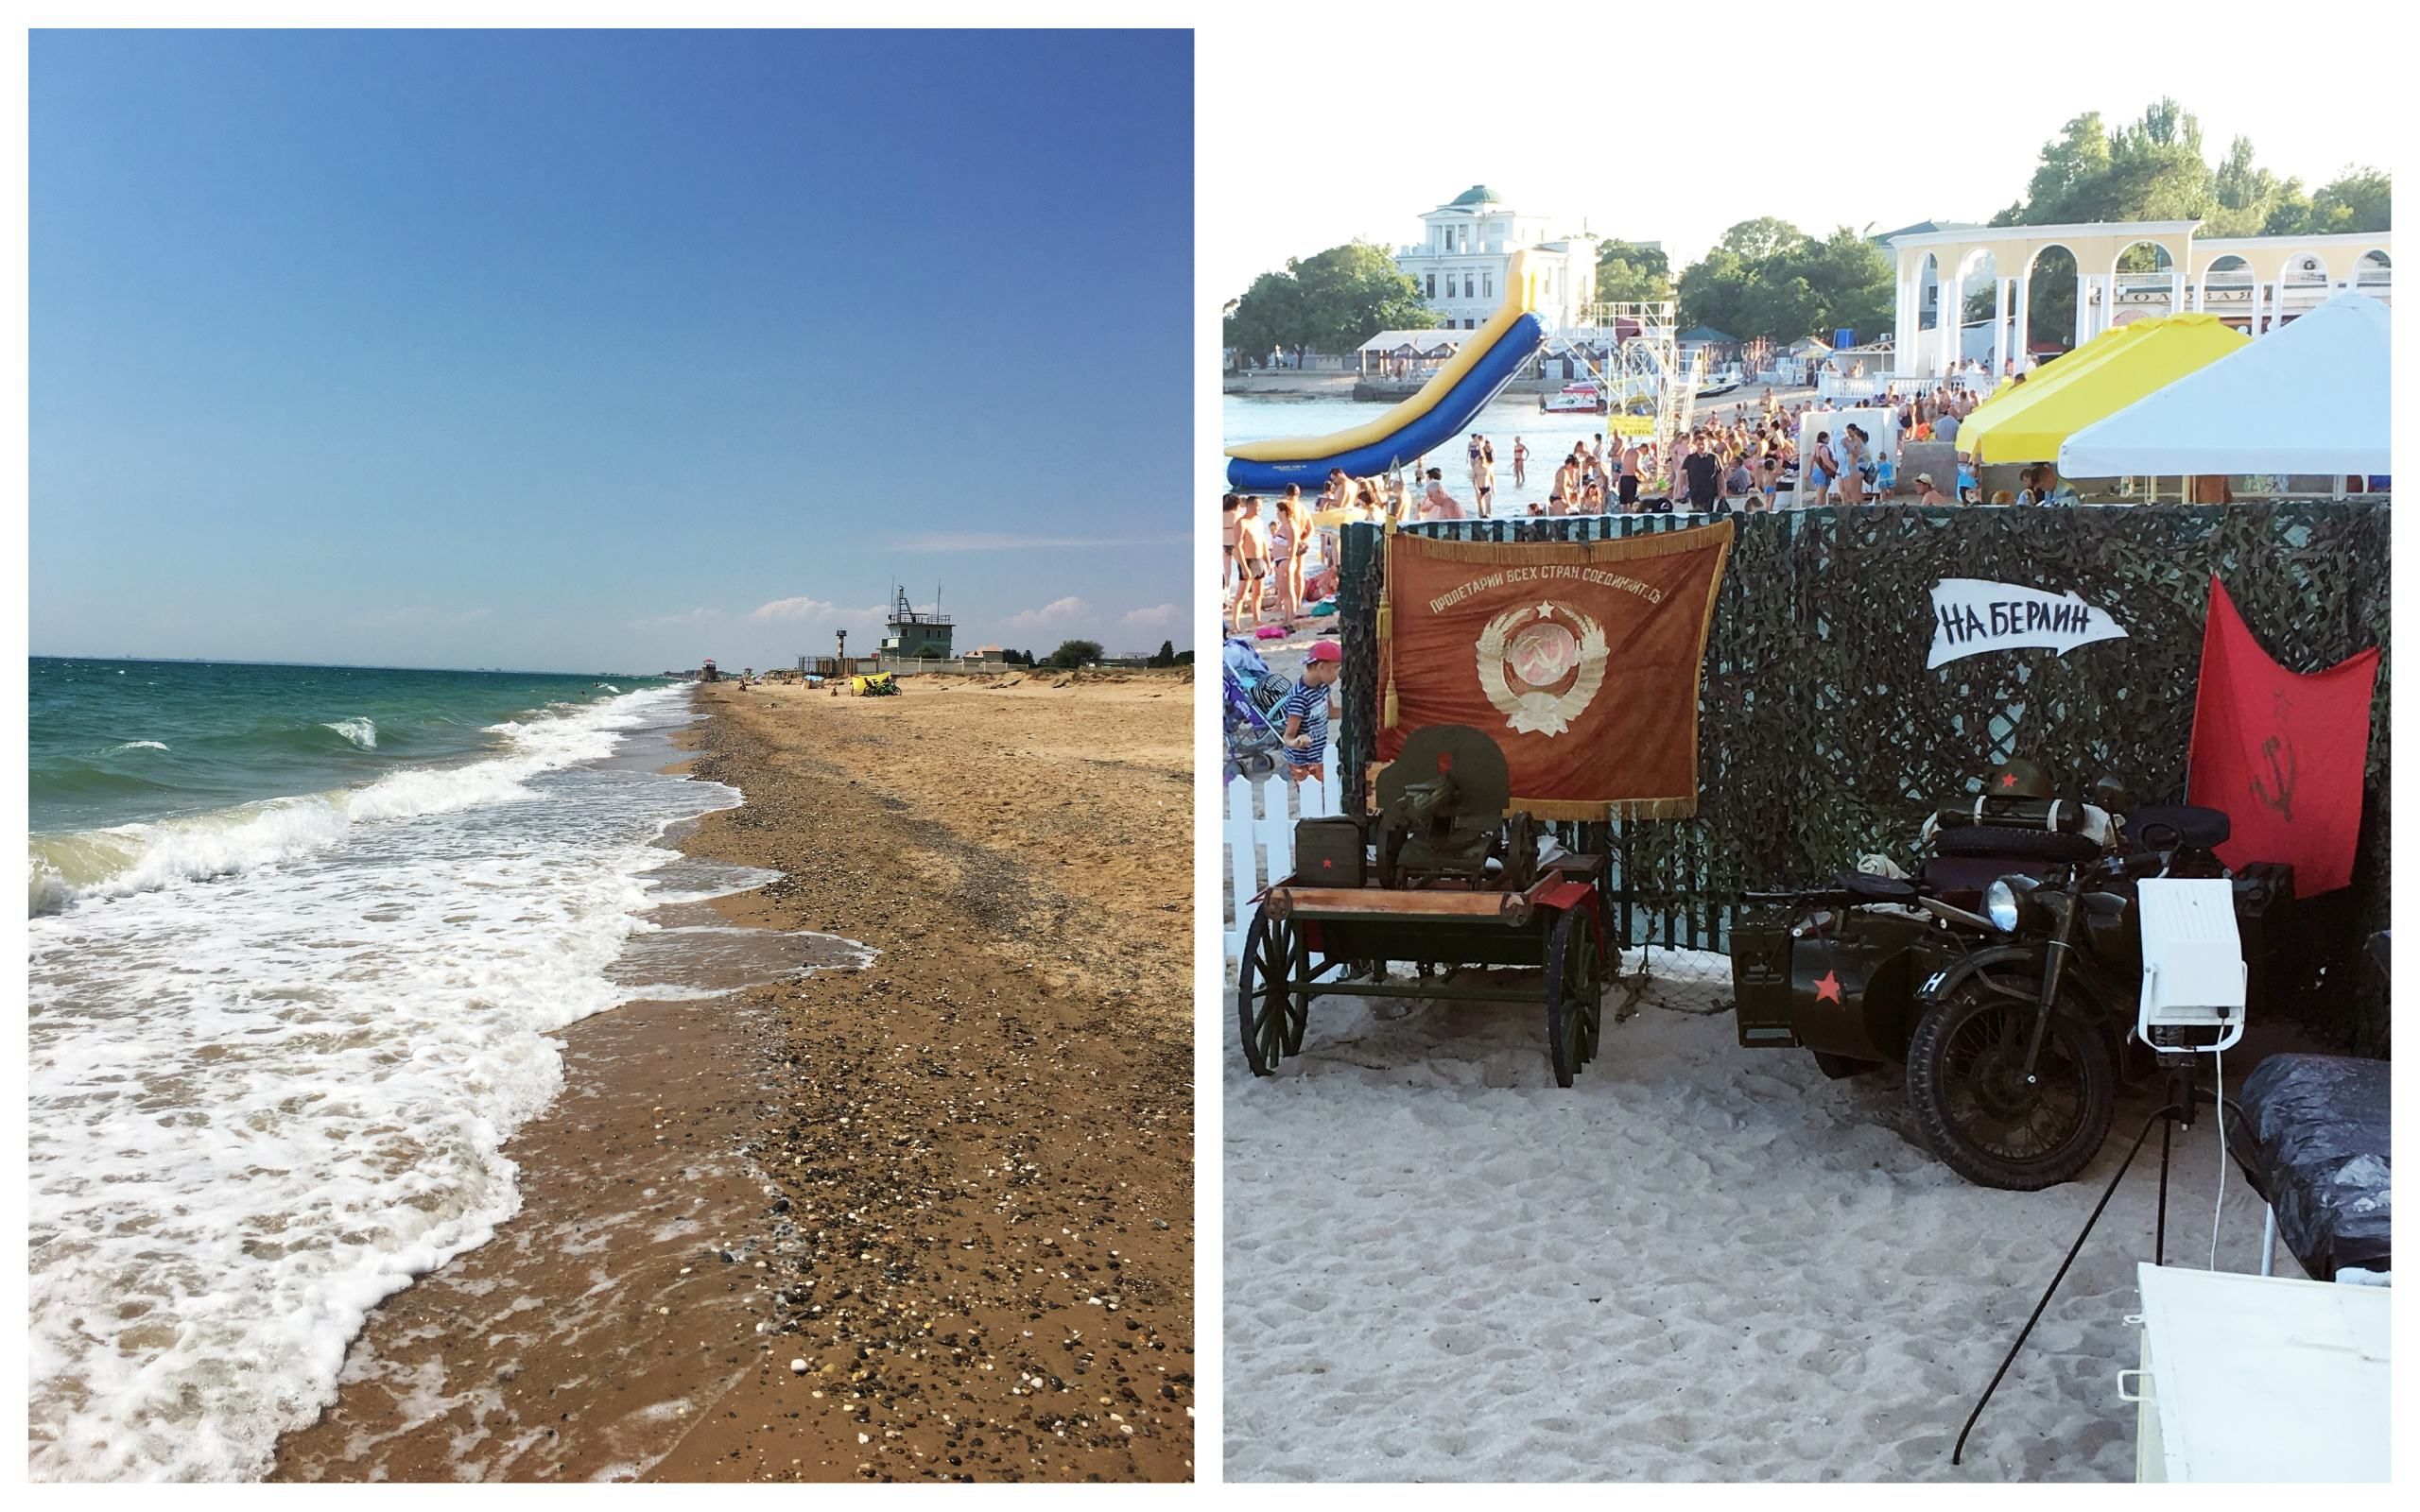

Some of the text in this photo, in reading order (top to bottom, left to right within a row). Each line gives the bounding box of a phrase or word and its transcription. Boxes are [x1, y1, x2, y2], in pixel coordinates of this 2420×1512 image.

[1429, 573, 1504, 614] ПРОЛЕТАРИИ
[1507, 566, 1538, 583] ВСЕХ
[1941, 601, 2091, 644] НА БЕРЛИН
